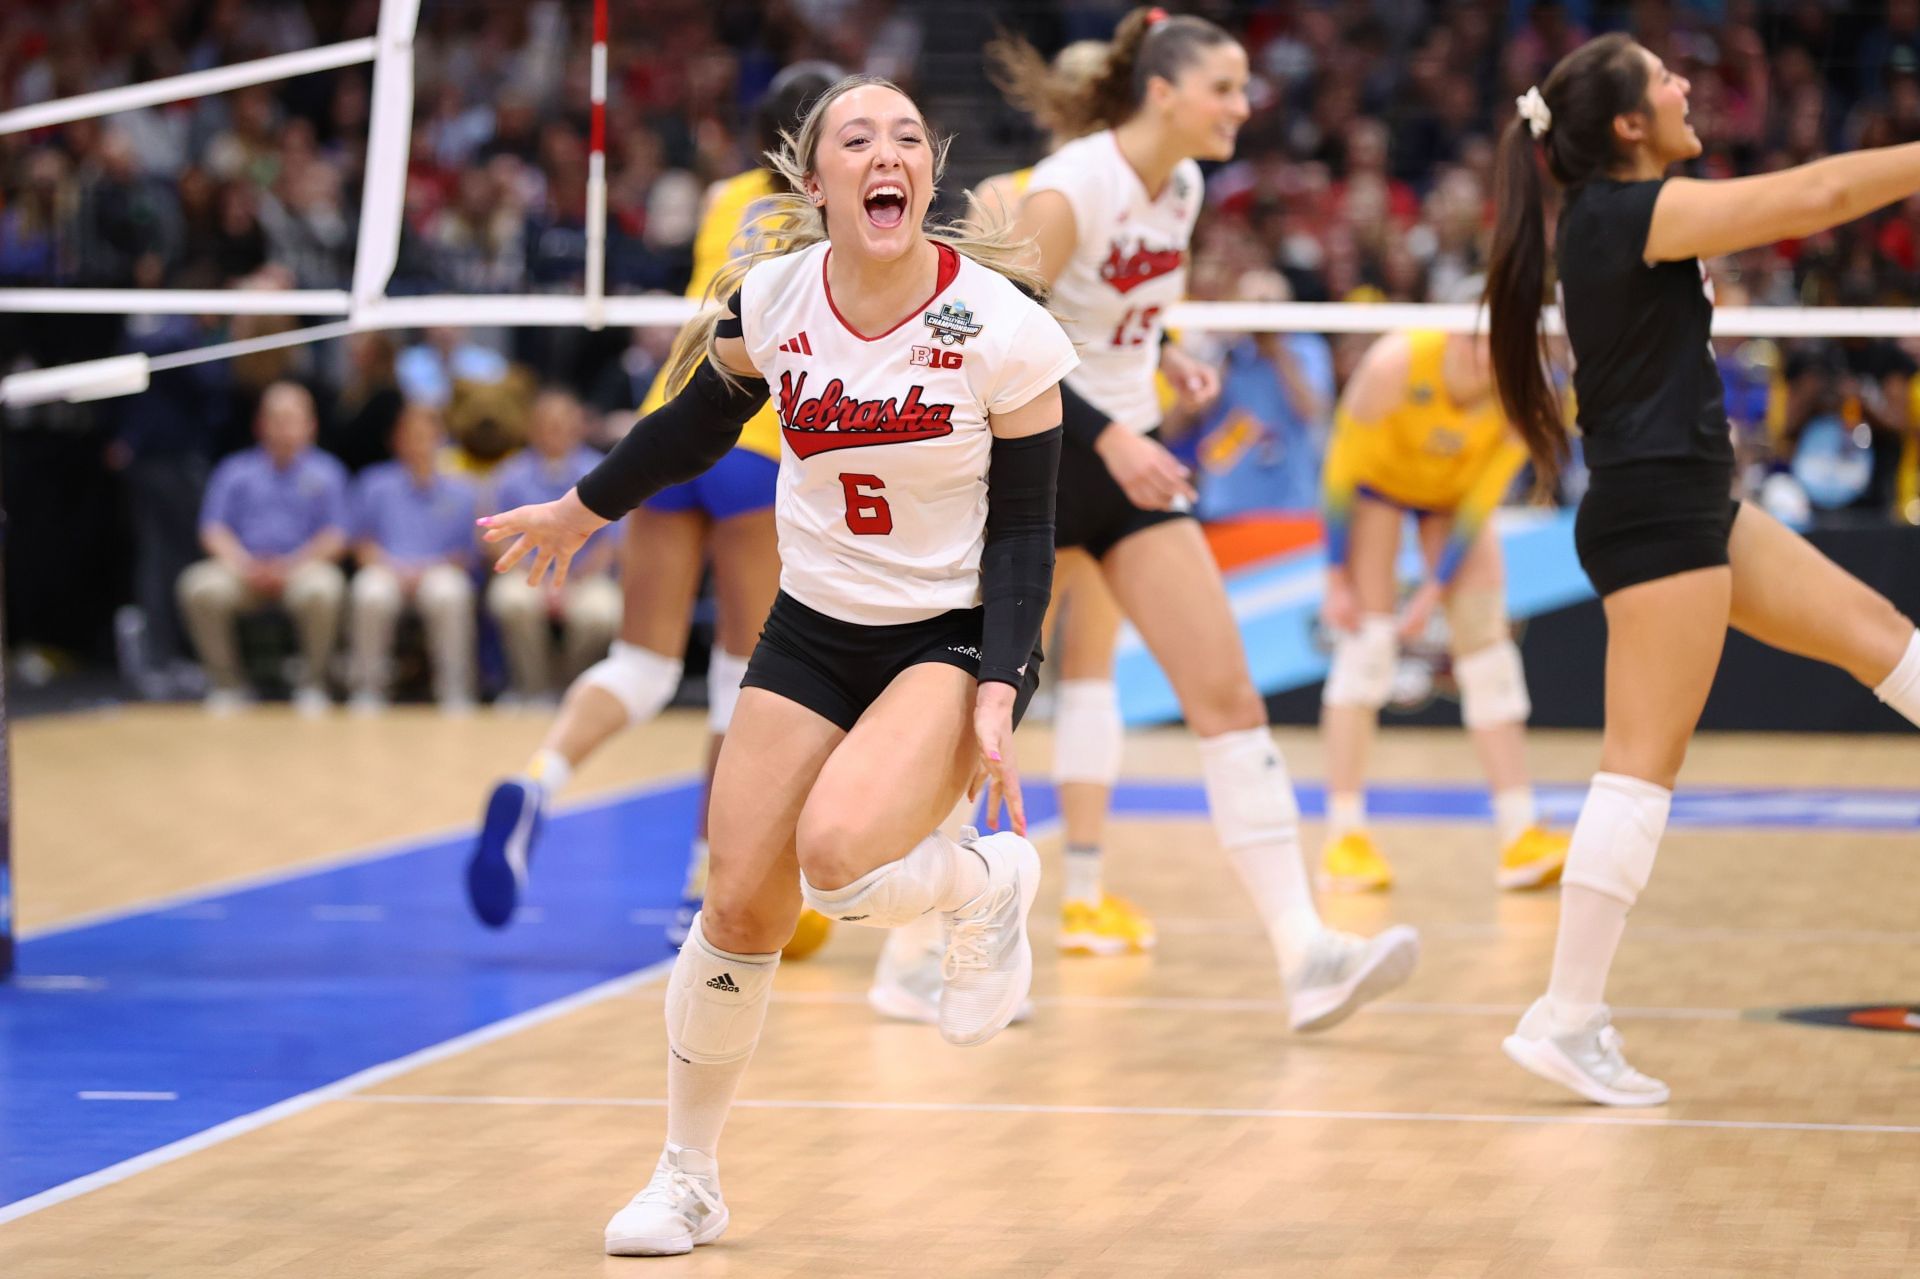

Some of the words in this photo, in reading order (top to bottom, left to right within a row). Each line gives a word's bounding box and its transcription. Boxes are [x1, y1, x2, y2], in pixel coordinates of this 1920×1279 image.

[928, 317, 979, 333] CHAMPIONSHIP
[777, 370, 955, 434] Nebraska
[838, 473, 893, 535] 6
[706, 981, 740, 993] adidas
